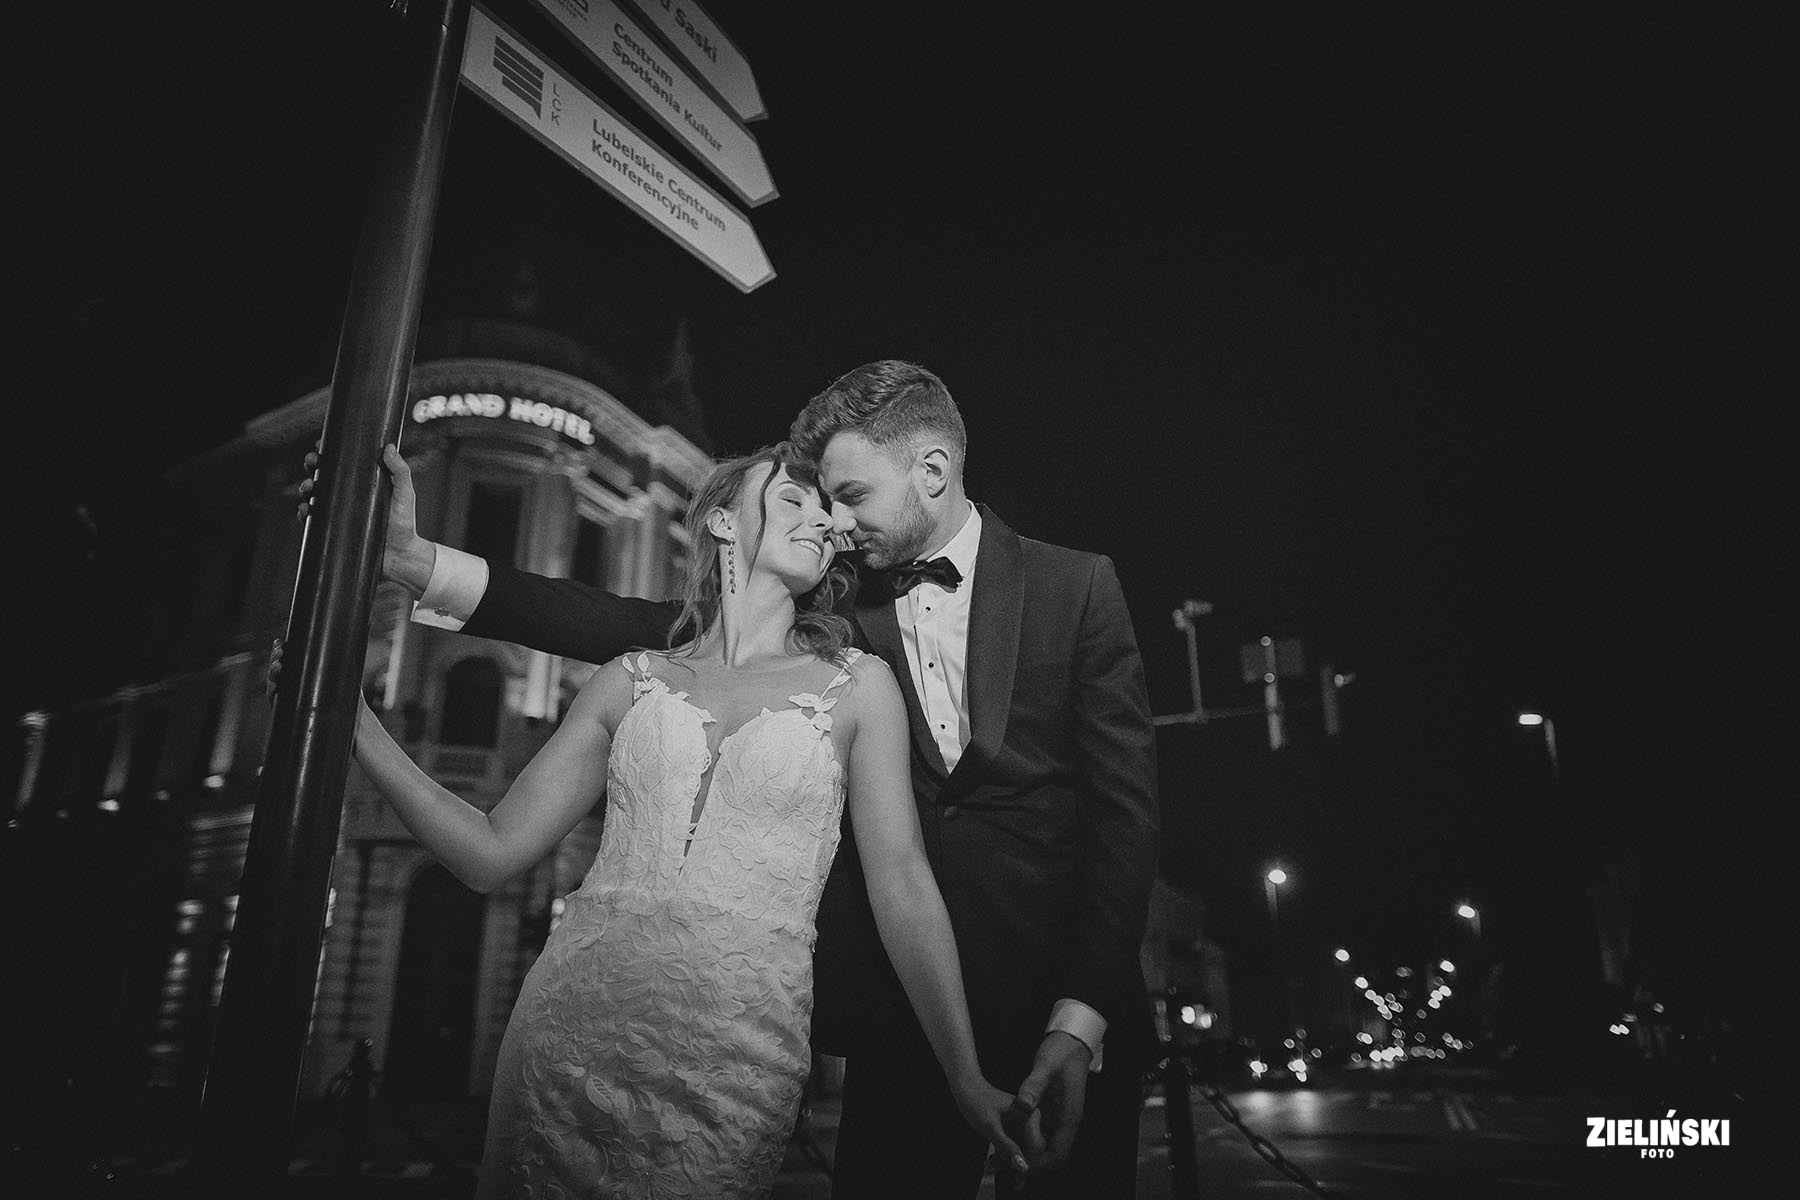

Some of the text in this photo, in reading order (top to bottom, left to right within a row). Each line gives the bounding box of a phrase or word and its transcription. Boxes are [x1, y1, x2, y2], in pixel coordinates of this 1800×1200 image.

[613, 22, 673, 87] Centrum
[674, 7, 718, 64] Saski
[611, 40, 722, 152] Spotkania Kultur
[591, 138, 699, 231] Konferencyjne
[592, 118, 726, 232] Lubelskie Centrum
[412, 393, 596, 446] GRAND HOTEL
